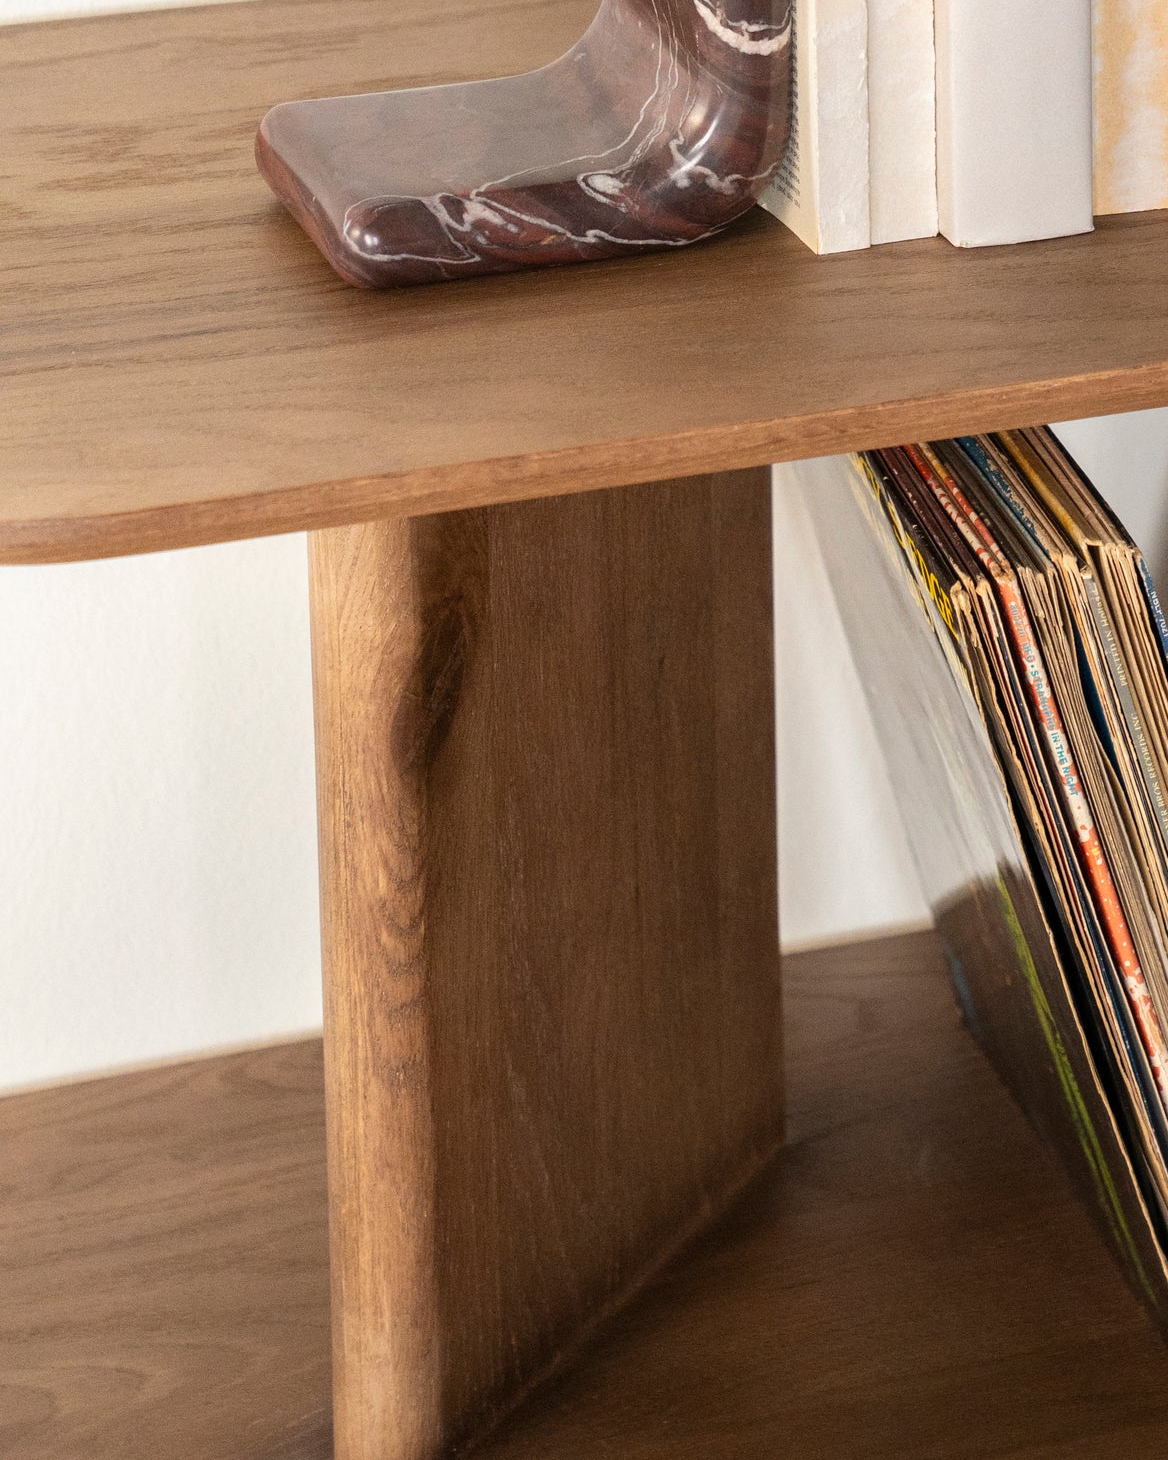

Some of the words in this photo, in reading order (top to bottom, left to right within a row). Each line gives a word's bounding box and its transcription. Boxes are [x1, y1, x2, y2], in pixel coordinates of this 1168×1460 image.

[1030, 670, 1056, 731] STRANGERS
[1054, 745, 1067, 765] THE
[1062, 766, 1079, 797] NIGHT
